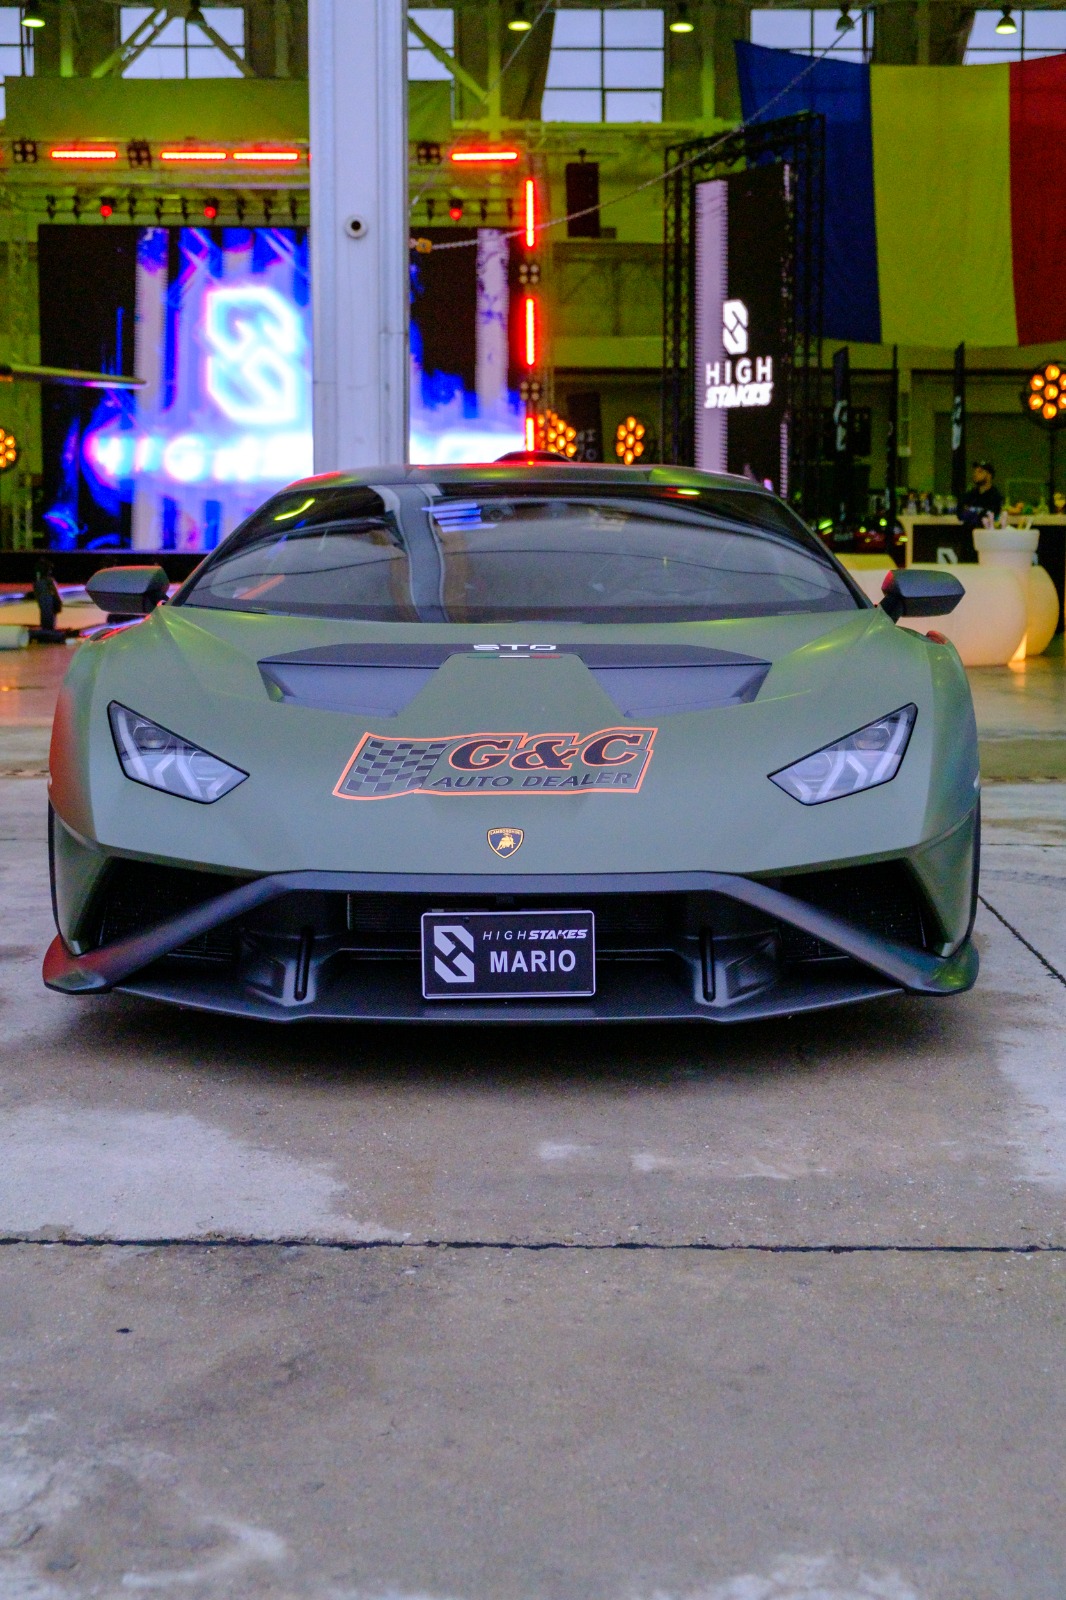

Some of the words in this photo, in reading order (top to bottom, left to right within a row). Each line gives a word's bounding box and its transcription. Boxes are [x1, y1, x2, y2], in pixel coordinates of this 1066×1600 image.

[705, 355, 773, 385] HIGH
[448, 733, 644, 771] G&C
[430, 774, 514, 788] AUTO
[521, 771, 633, 788] DEALER
[490, 949, 576, 973] MARIO
